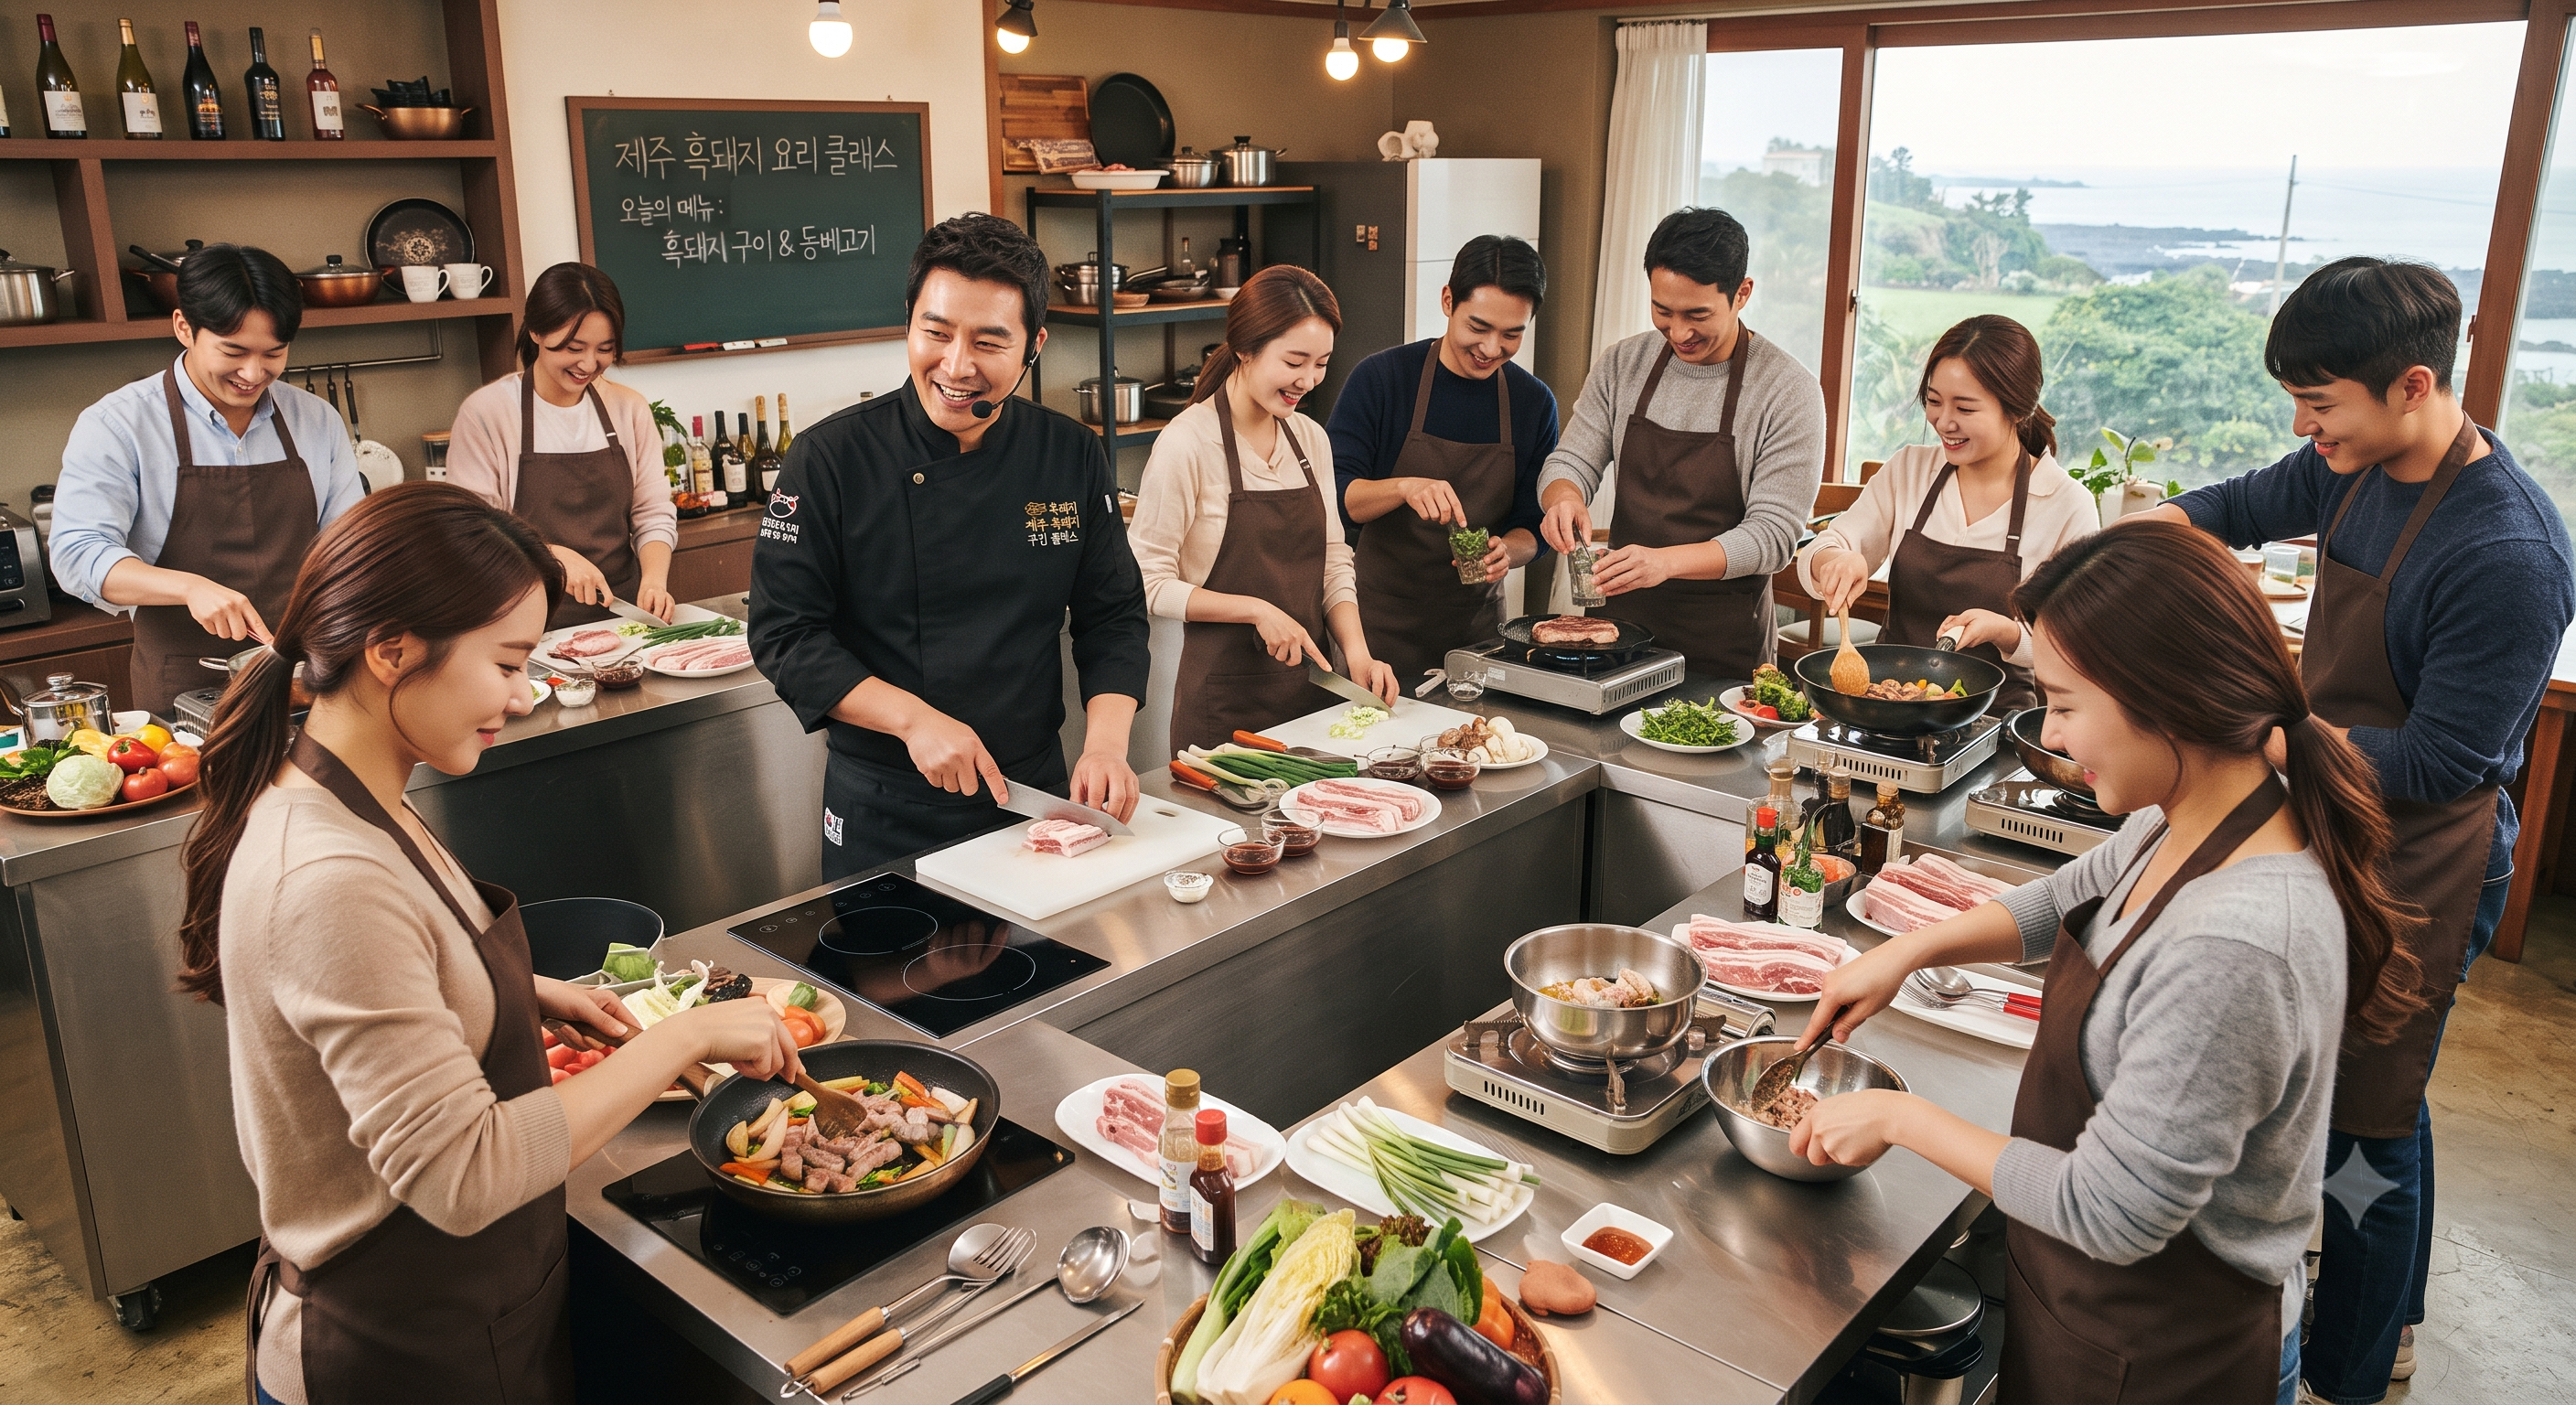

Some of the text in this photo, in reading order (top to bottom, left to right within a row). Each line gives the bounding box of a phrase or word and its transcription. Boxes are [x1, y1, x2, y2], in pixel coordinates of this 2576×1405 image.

[616, 132, 897, 180] 제주 흑돼지 요리 클래스
[621, 196, 670, 225] 오늘의
[662, 225, 875, 268] 흑돼지 구이 & 동베고기
